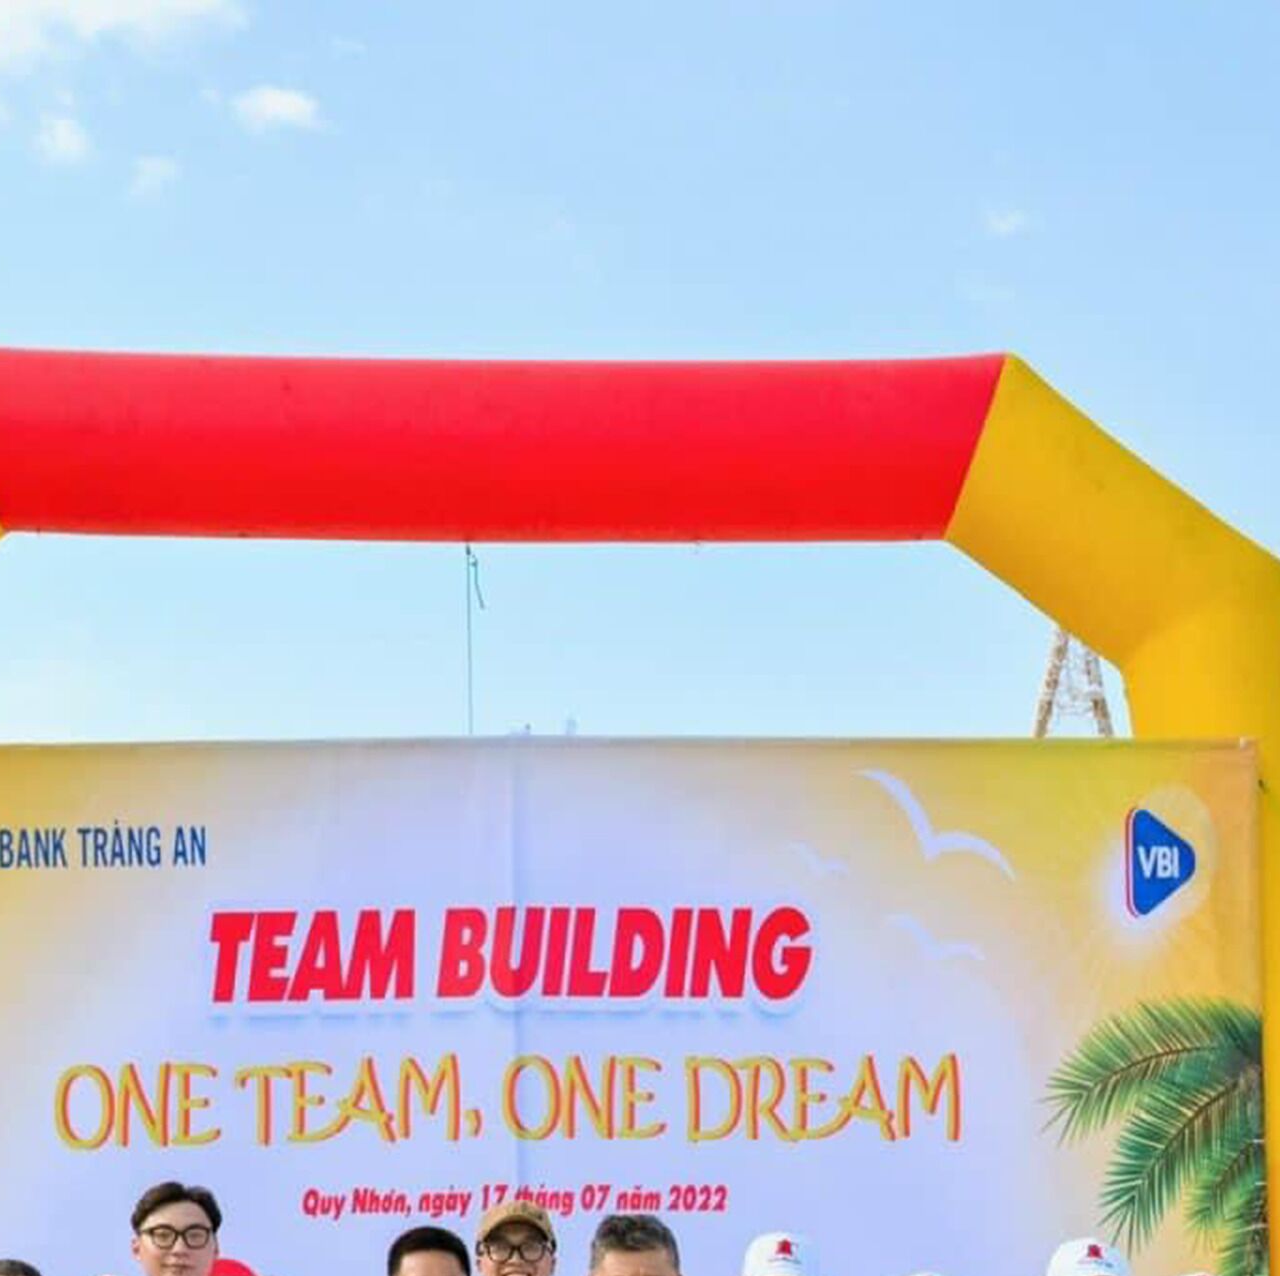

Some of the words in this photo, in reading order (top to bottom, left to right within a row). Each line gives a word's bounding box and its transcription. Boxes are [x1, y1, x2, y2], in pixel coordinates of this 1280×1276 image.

[78, 819, 161, 868] TRÀNG
[172, 825, 207, 866] AN
[1136, 844, 1180, 879] VBI
[210, 909, 416, 1003] TEAM
[436, 906, 813, 1001] BUILDING
[54, 1063, 222, 1151] ONE
[234, 1054, 483, 1147] TEAM,
[501, 1054, 668, 1142] ONE
[683, 1053, 961, 1143] DREAM
[302, 1187, 346, 1221] Quy
[351, 1187, 412, 1216] Nhơn,
[418, 1185, 472, 1217] ngày
[482, 1184, 508, 1212] 17
[514, 1183, 575, 1217] tháng
[581, 1184, 611, 1211] 07
[616, 1184, 661, 1211] năm
[668, 1184, 728, 1212] 2022
